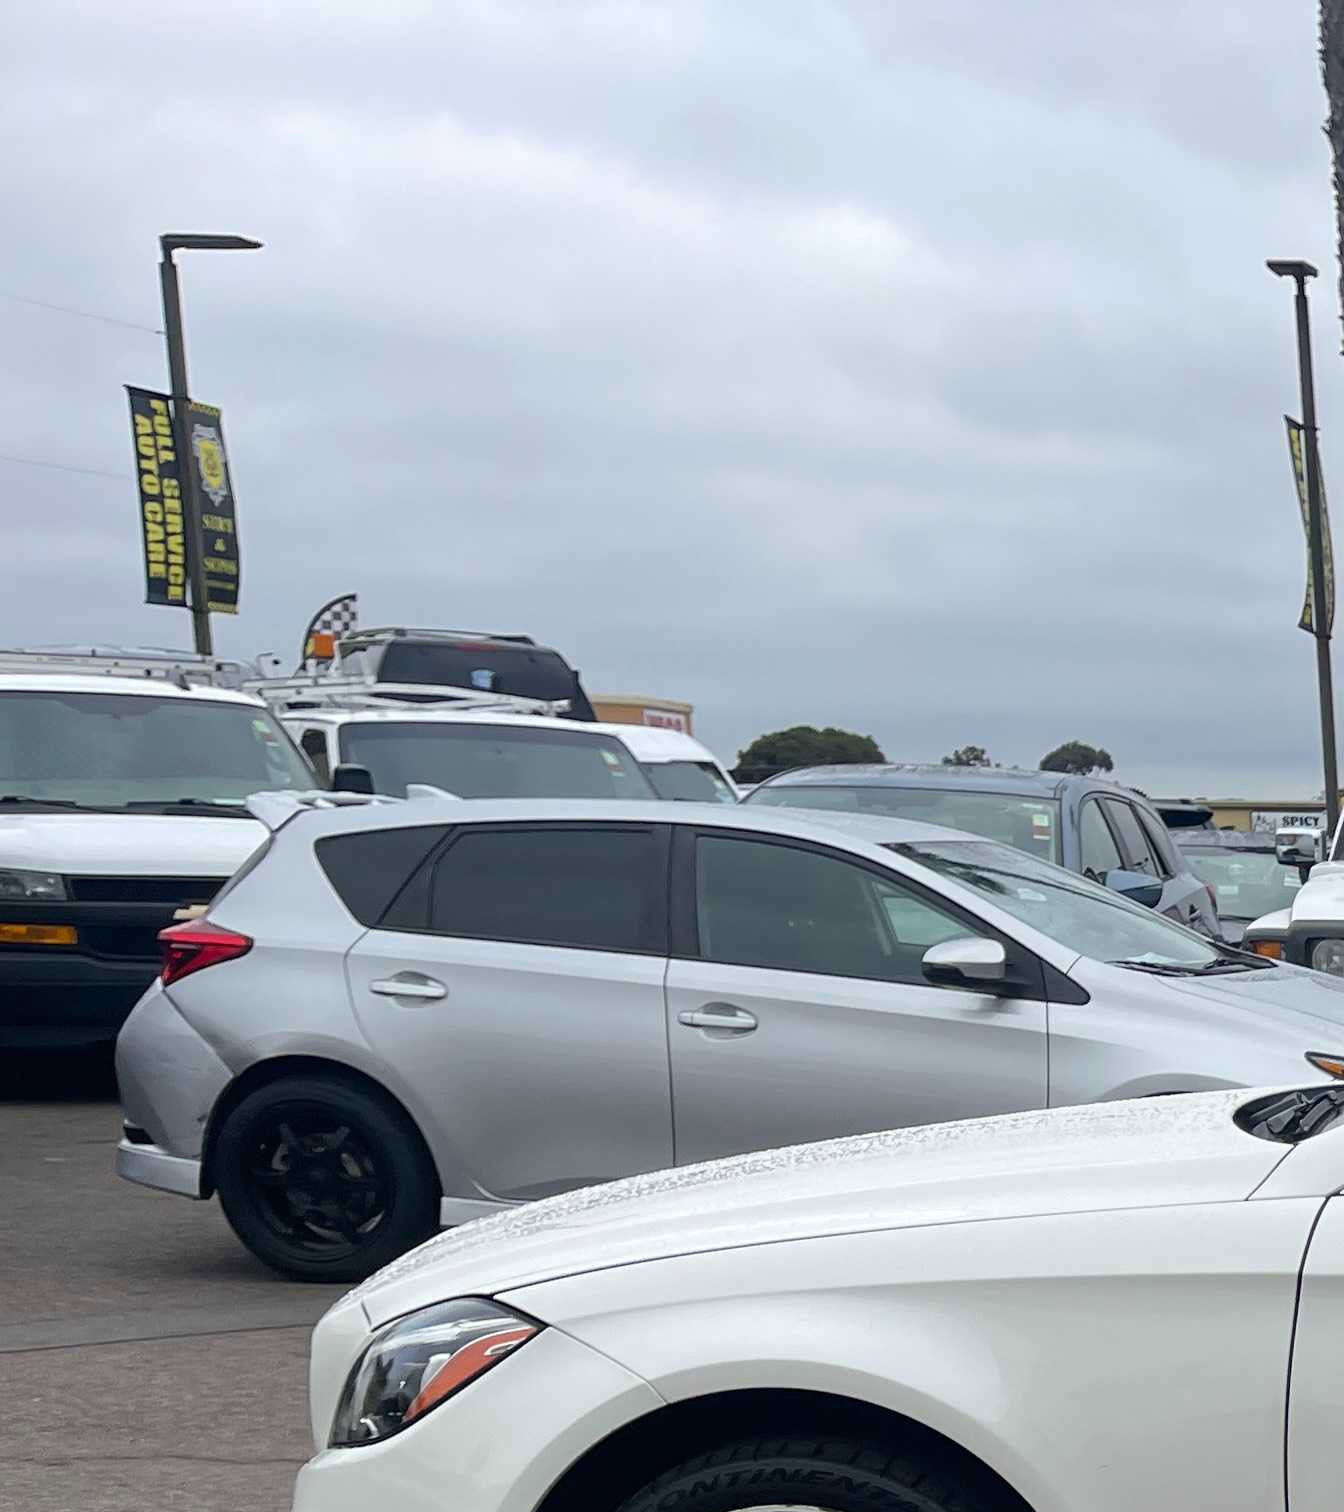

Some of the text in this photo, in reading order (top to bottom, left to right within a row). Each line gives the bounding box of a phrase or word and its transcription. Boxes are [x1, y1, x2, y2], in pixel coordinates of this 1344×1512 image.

[134, 413, 168, 578] AUTO CARE
[150, 399, 186, 601] FULL SERVICE
[1281, 815, 1321, 827] SPICY
